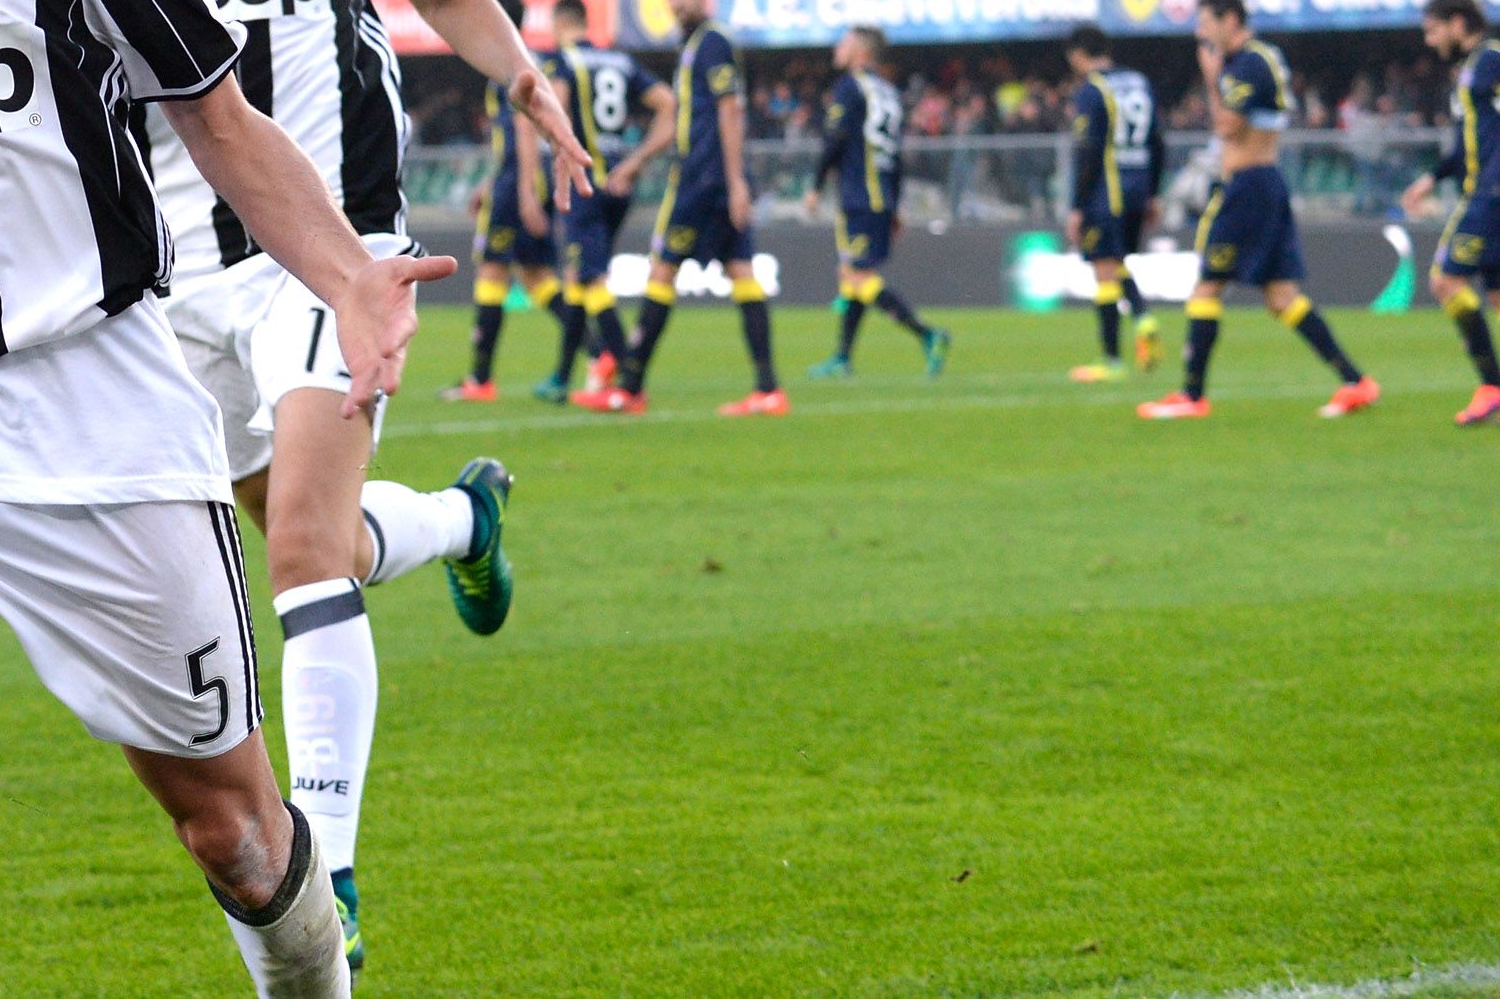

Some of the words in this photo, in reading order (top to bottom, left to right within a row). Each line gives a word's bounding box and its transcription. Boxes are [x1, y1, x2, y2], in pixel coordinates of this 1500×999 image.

[593, 67, 628, 131] 8
[184, 636, 230, 748] 5
[291, 777, 350, 796] JUVE
